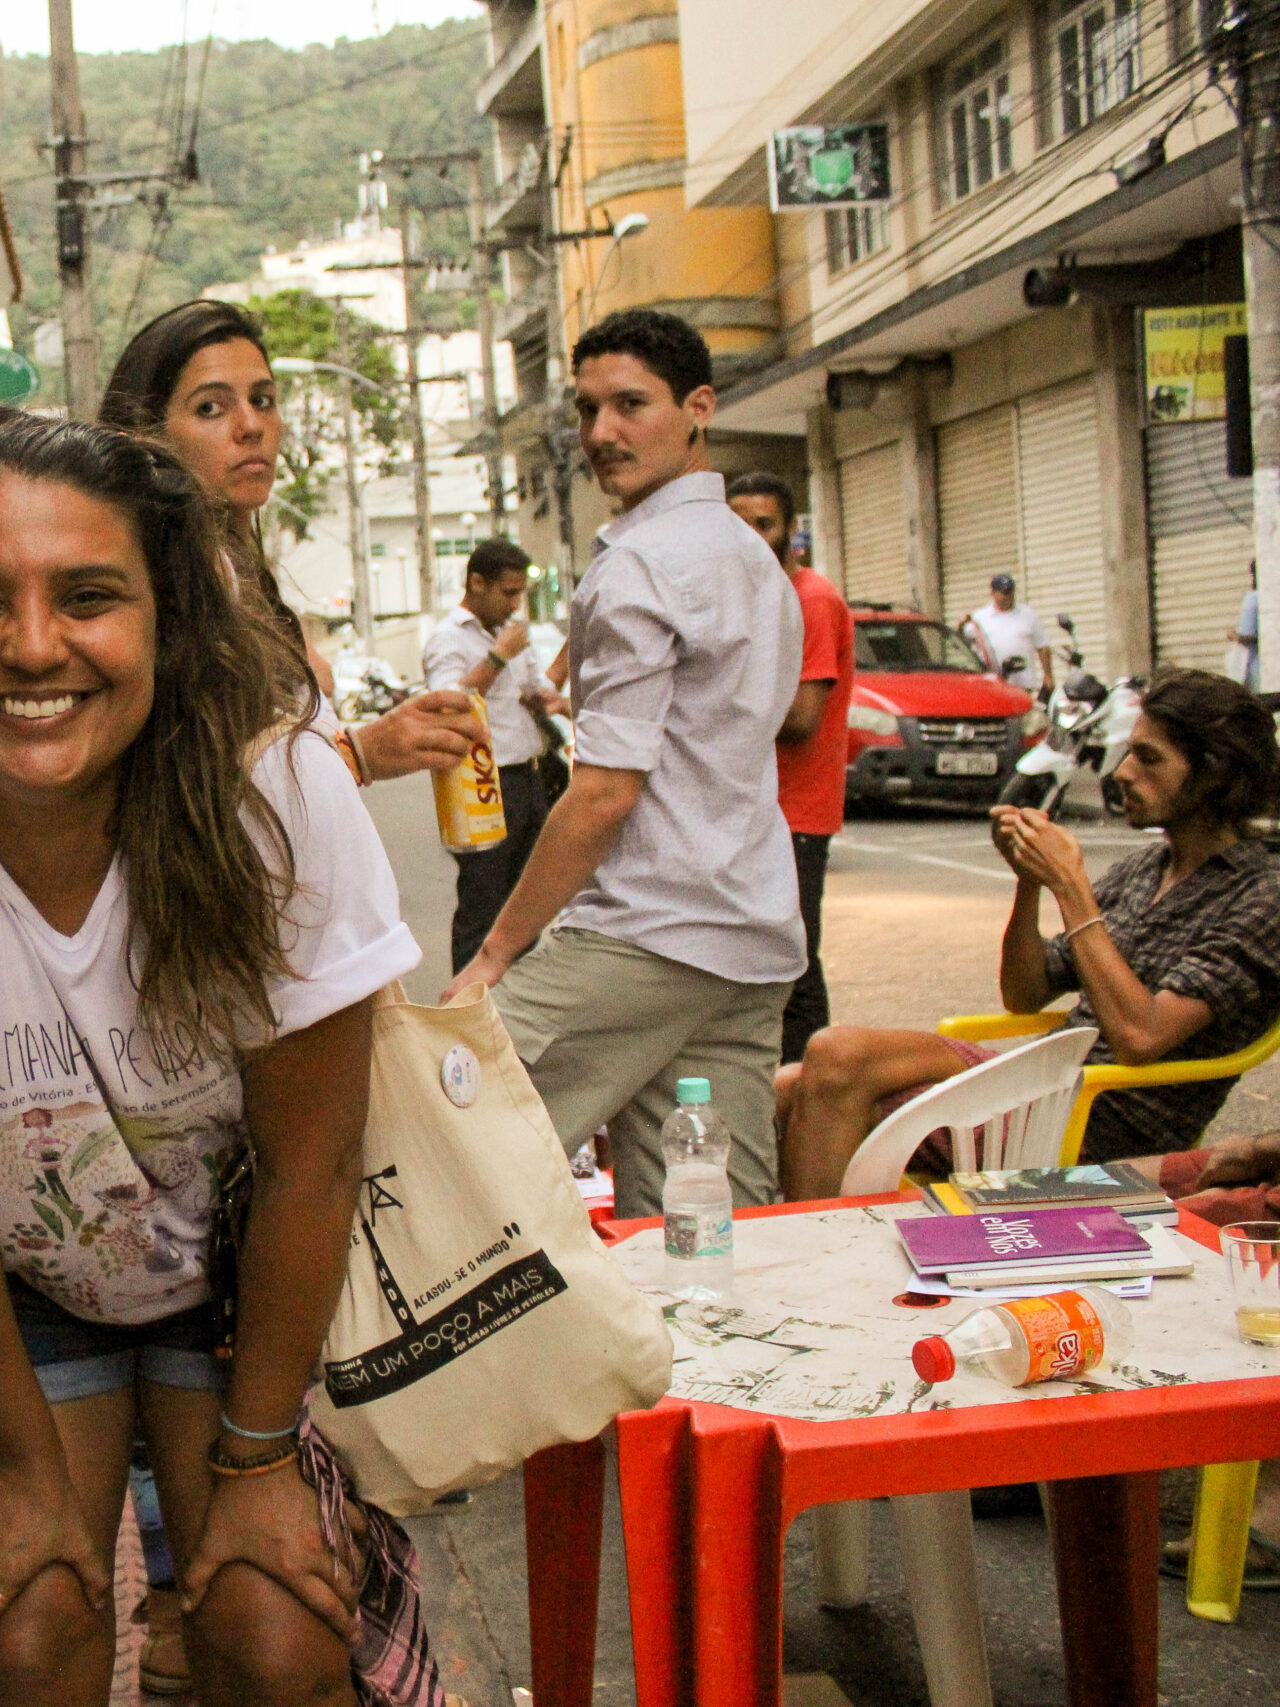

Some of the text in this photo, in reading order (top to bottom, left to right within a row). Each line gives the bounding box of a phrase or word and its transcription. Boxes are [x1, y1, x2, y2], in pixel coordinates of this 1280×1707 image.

[471, 742, 499, 805] SKO
[12, 1096, 26, 1107] de
[29, 1088, 74, 1101] Vitória
[1006, 1218, 1042, 1250] Vozes
[372, 1351, 409, 1377] UM
[477, 1300, 494, 1320] A
[493, 1269, 543, 1306] MAIS
